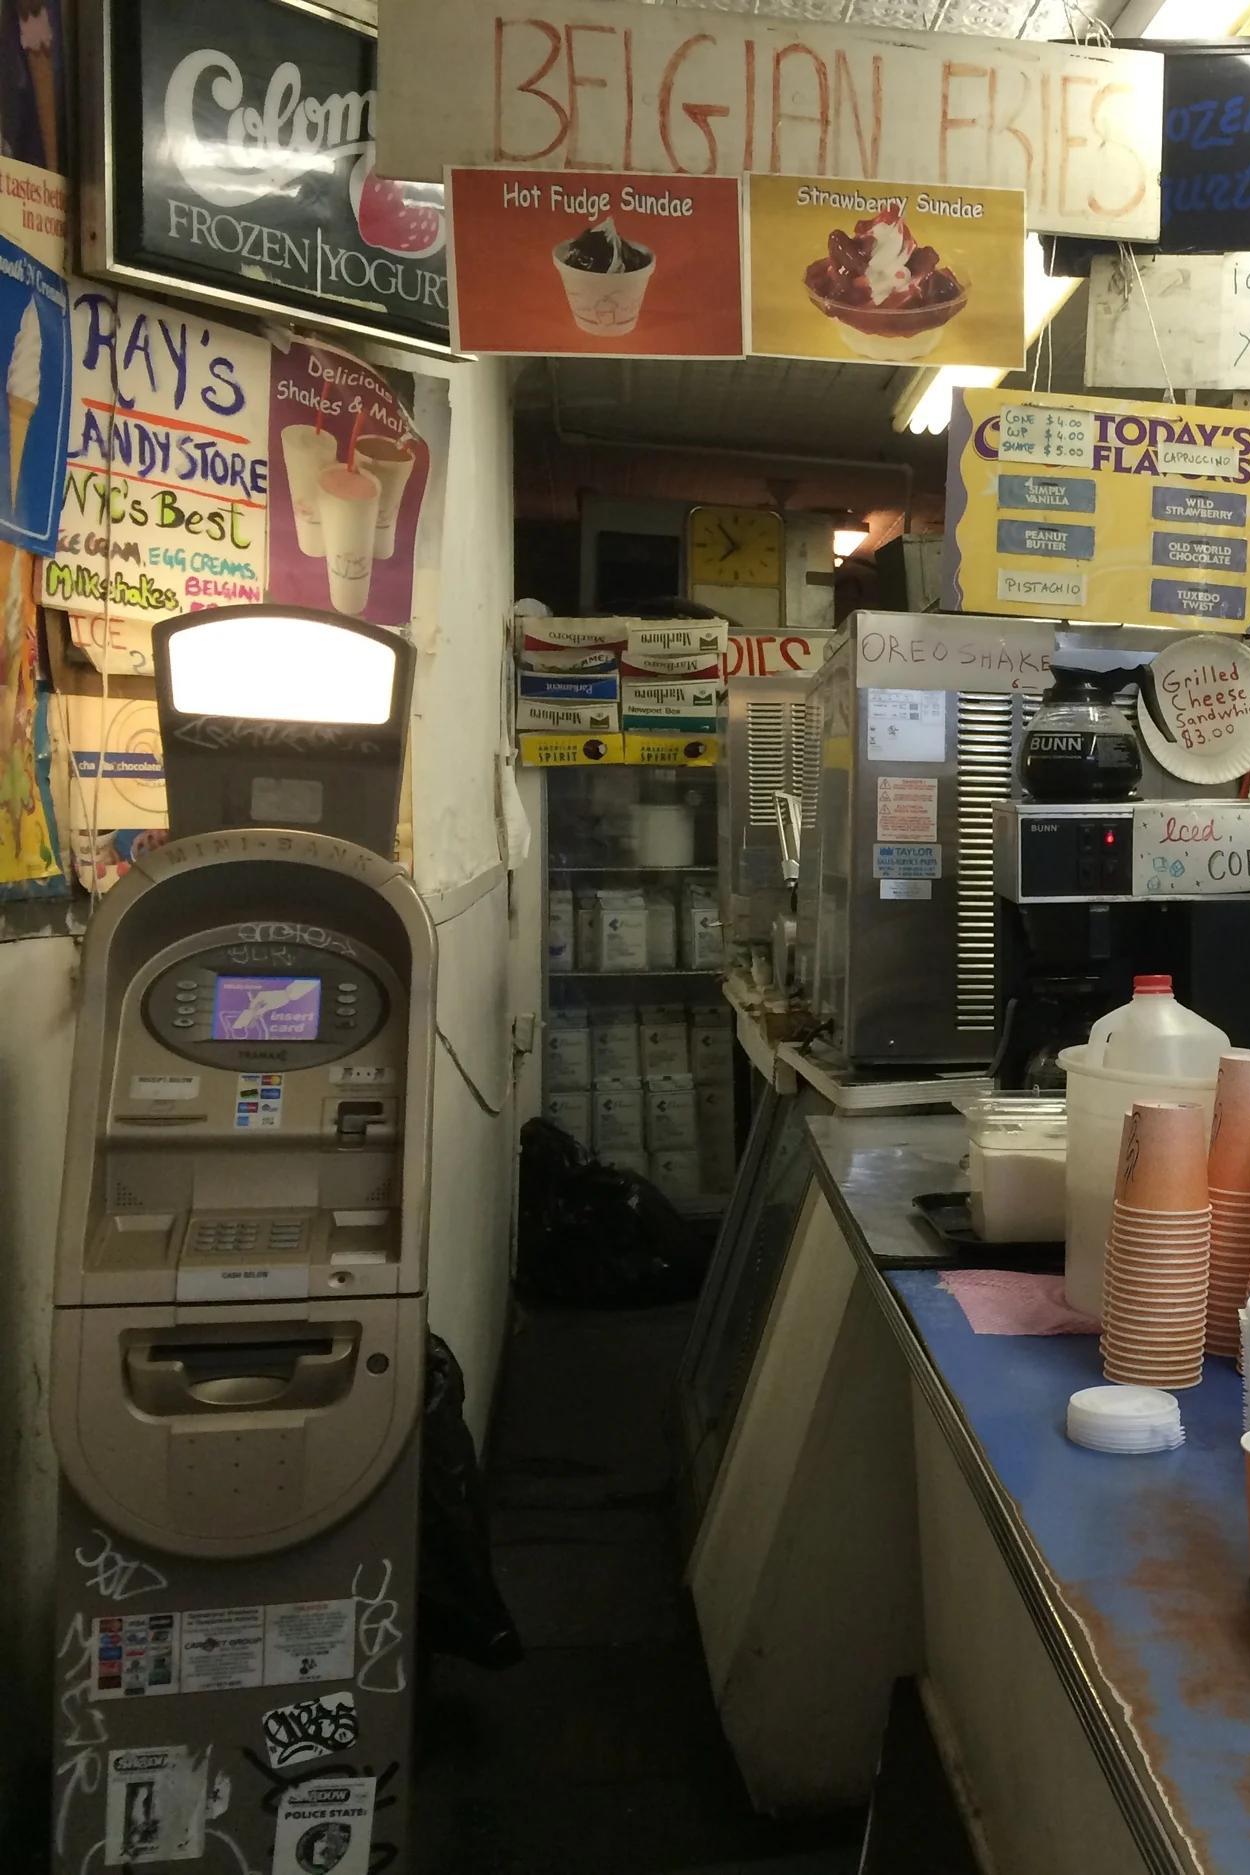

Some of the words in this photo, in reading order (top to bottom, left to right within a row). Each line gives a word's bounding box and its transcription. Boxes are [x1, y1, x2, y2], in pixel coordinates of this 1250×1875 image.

[495, 17, 883, 174] BELGIAN
[940, 57, 1147, 219] FRIES
[164, 49, 378, 207] Colom
[5, 174, 41, 202] tastes
[503, 182, 543, 208] Hot
[550, 187, 611, 220] Fudge
[620, 188, 694, 218] Sundae
[797, 186, 906, 216] Strawberry
[912, 194, 985, 218] Sundae
[22, 203, 34, 229] in
[167, 200, 309, 272] FROZEN
[321, 246, 449, 310] YOGURT
[308, 355, 392, 403] Delicious
[277, 380, 343, 416] Shakes
[348, 396, 363, 414] &
[1005, 409, 1035, 427] CONE
[1164, 451, 1231, 467] CAPPUCCINO
[177, 435, 268, 500] STORE
[1028, 484, 1066, 497] SIMPLY
[1025, 493, 1070, 506] VANILLA
[1186, 498, 1214, 509] WILD
[151, 490, 251, 549] Best
[1165, 506, 1233, 520] STRAWBERRY
[1025, 530, 1068, 542] PEANUT
[1026, 539, 1067, 551] BUTTER
[1168, 541, 1191, 552] OLD
[1193, 543, 1232, 557] WORLD
[149, 546, 187, 574] EGG
[1168, 551, 1231, 565] CHOCOLATE
[185, 576, 260, 601] BELGIAN
[1005, 578, 1081, 595] PISTACHIO
[1177, 590, 1221, 603] TUXEDO
[1182, 600, 1214, 611] TWIST
[69, 614, 127, 650] ICE
[549, 631, 606, 643] Marlboro
[641, 632, 691, 649] Marlboro
[862, 632, 949, 663] OREO
[957, 644, 1051, 673] SHAKE
[644, 659, 698, 671] Marlboro
[1162, 662, 1240, 695] Grilled
[545, 683, 592, 694] Parliament
[634, 688, 685, 704] Marlboro
[1172, 685, 1248, 712] Cheese
[529, 708, 582, 726] Marlboro
[628, 706, 662, 714] Newport
[665, 706, 680, 714] Box
[1030, 736, 1083, 751] BUNN
[1181, 723, 1235, 750] $3.00
[538, 752, 578, 762] SPIRIT
[641, 753, 678, 761] SPIRIT
[168, 836, 373, 872] MINI-BANK
[894, 847, 933, 857] TAYLOR
[271, 1011, 314, 1021] insert
[270, 1023, 304, 1033] card
[285, 1809, 326, 1819] POLICE
